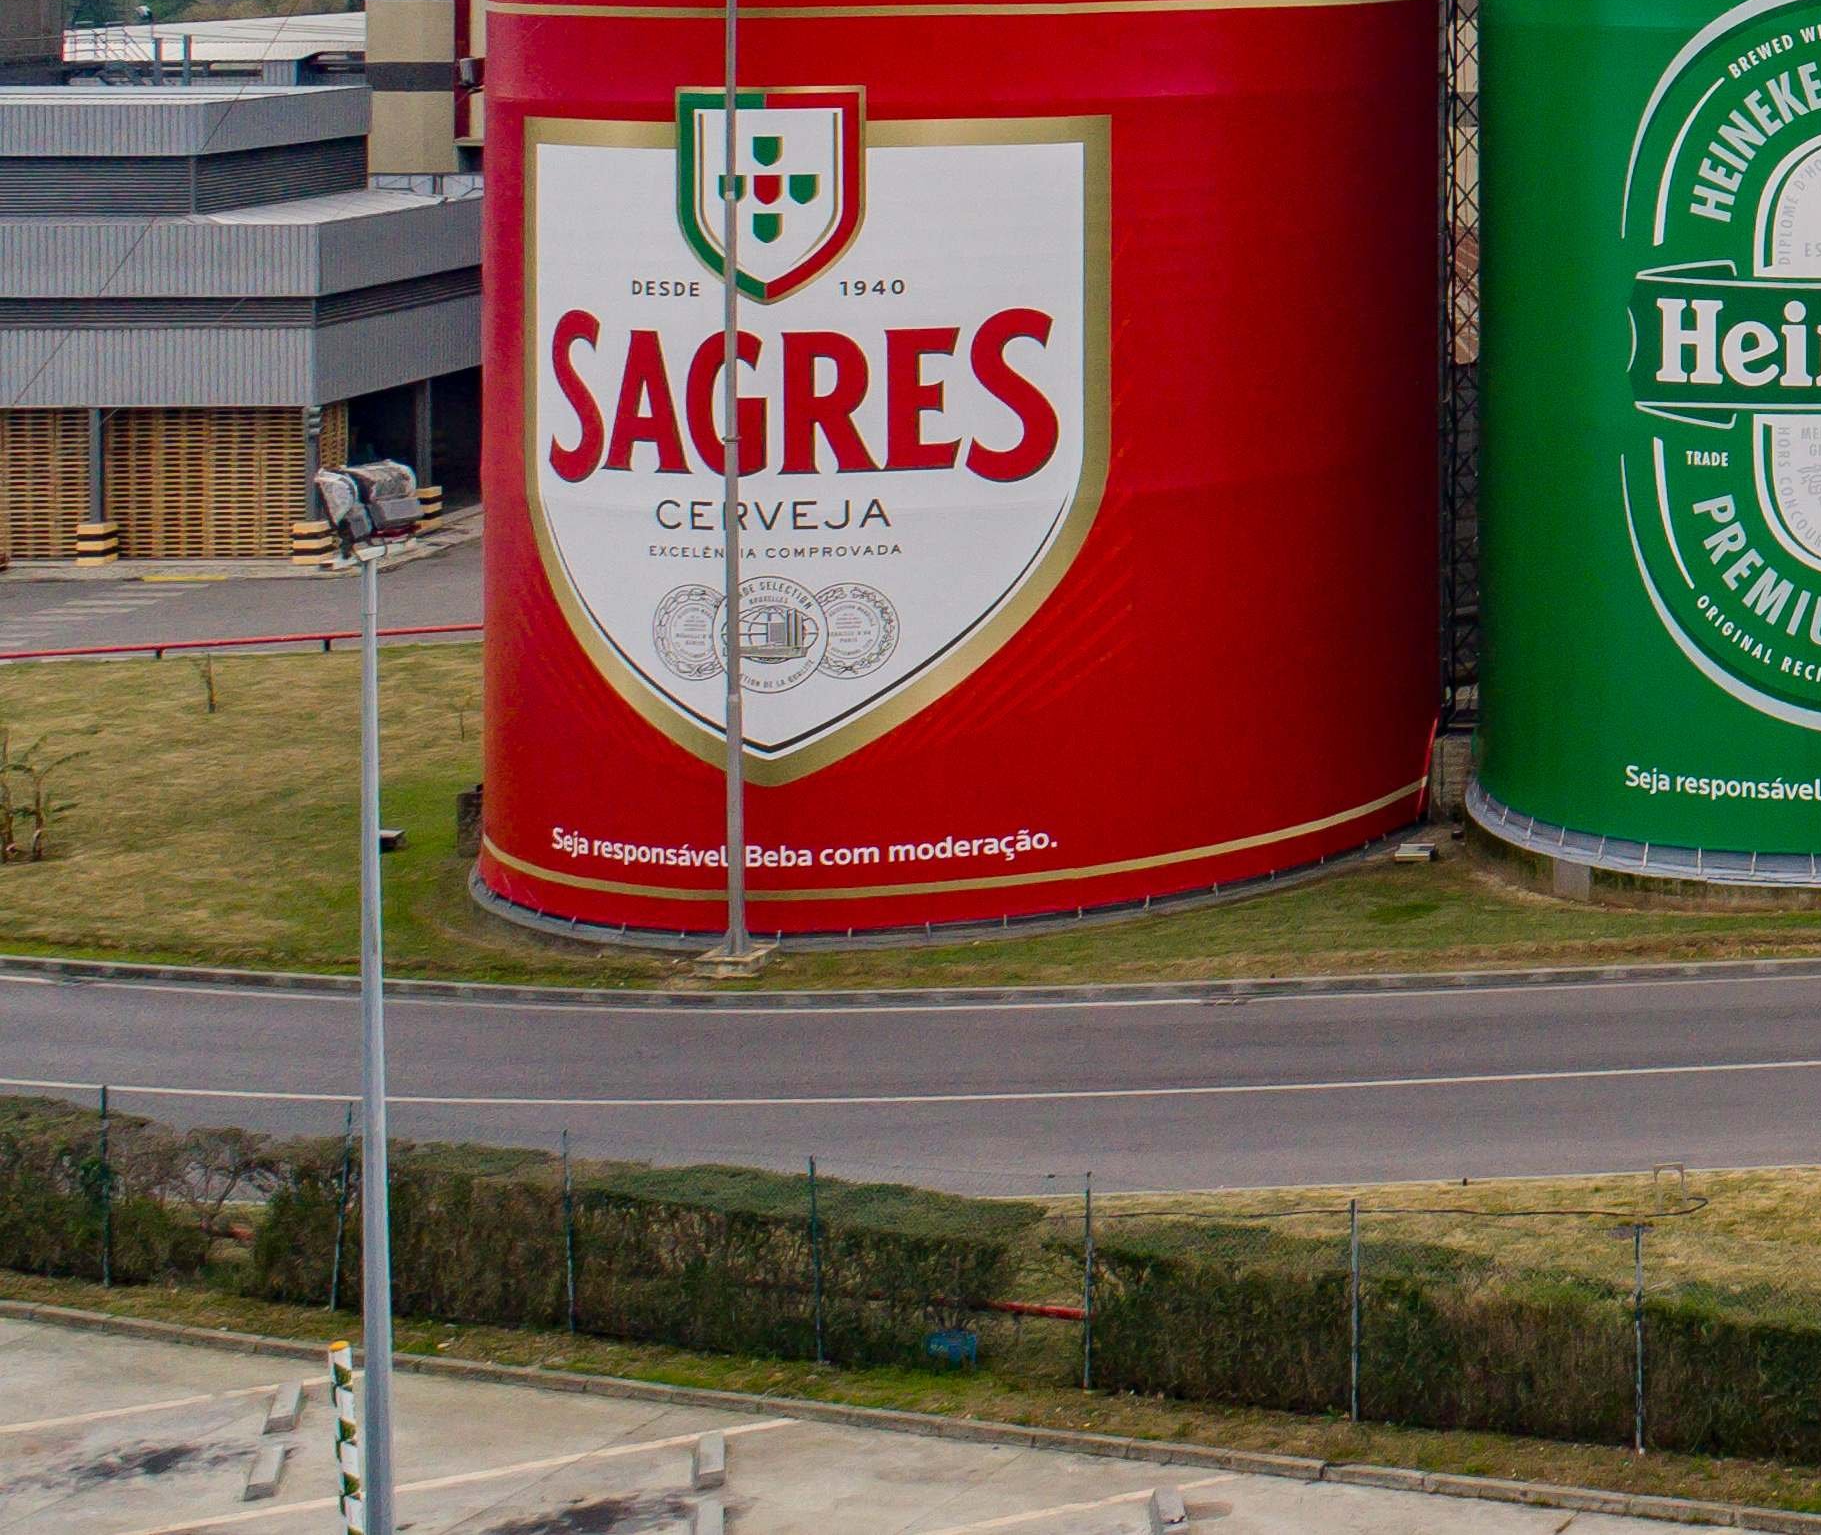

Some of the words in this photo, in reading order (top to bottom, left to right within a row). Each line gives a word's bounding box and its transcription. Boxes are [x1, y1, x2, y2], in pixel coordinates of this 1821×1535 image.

[1727, 33, 1794, 79] BREWED
[631, 278, 701, 298] DESDE
[838, 277, 907, 297] 1940
[549, 307, 1061, 484] SAGRES
[1686, 450, 1730, 468] TRADE
[1777, 426, 1791, 467] HORS
[655, 498, 892, 531] CERVEJA
[648, 543, 757, 559] EXCELÊNIA
[764, 544, 903, 559] COMPROVADA
[1696, 594, 1774, 667] ORIGINAL
[1625, 765, 1672, 796] Seja
[552, 826, 590, 859] Seja
[593, 838, 730, 869] responsável
[745, 844, 813, 869] Beba
[819, 845, 880, 867] com
[888, 828, 1060, 863] moderação.
